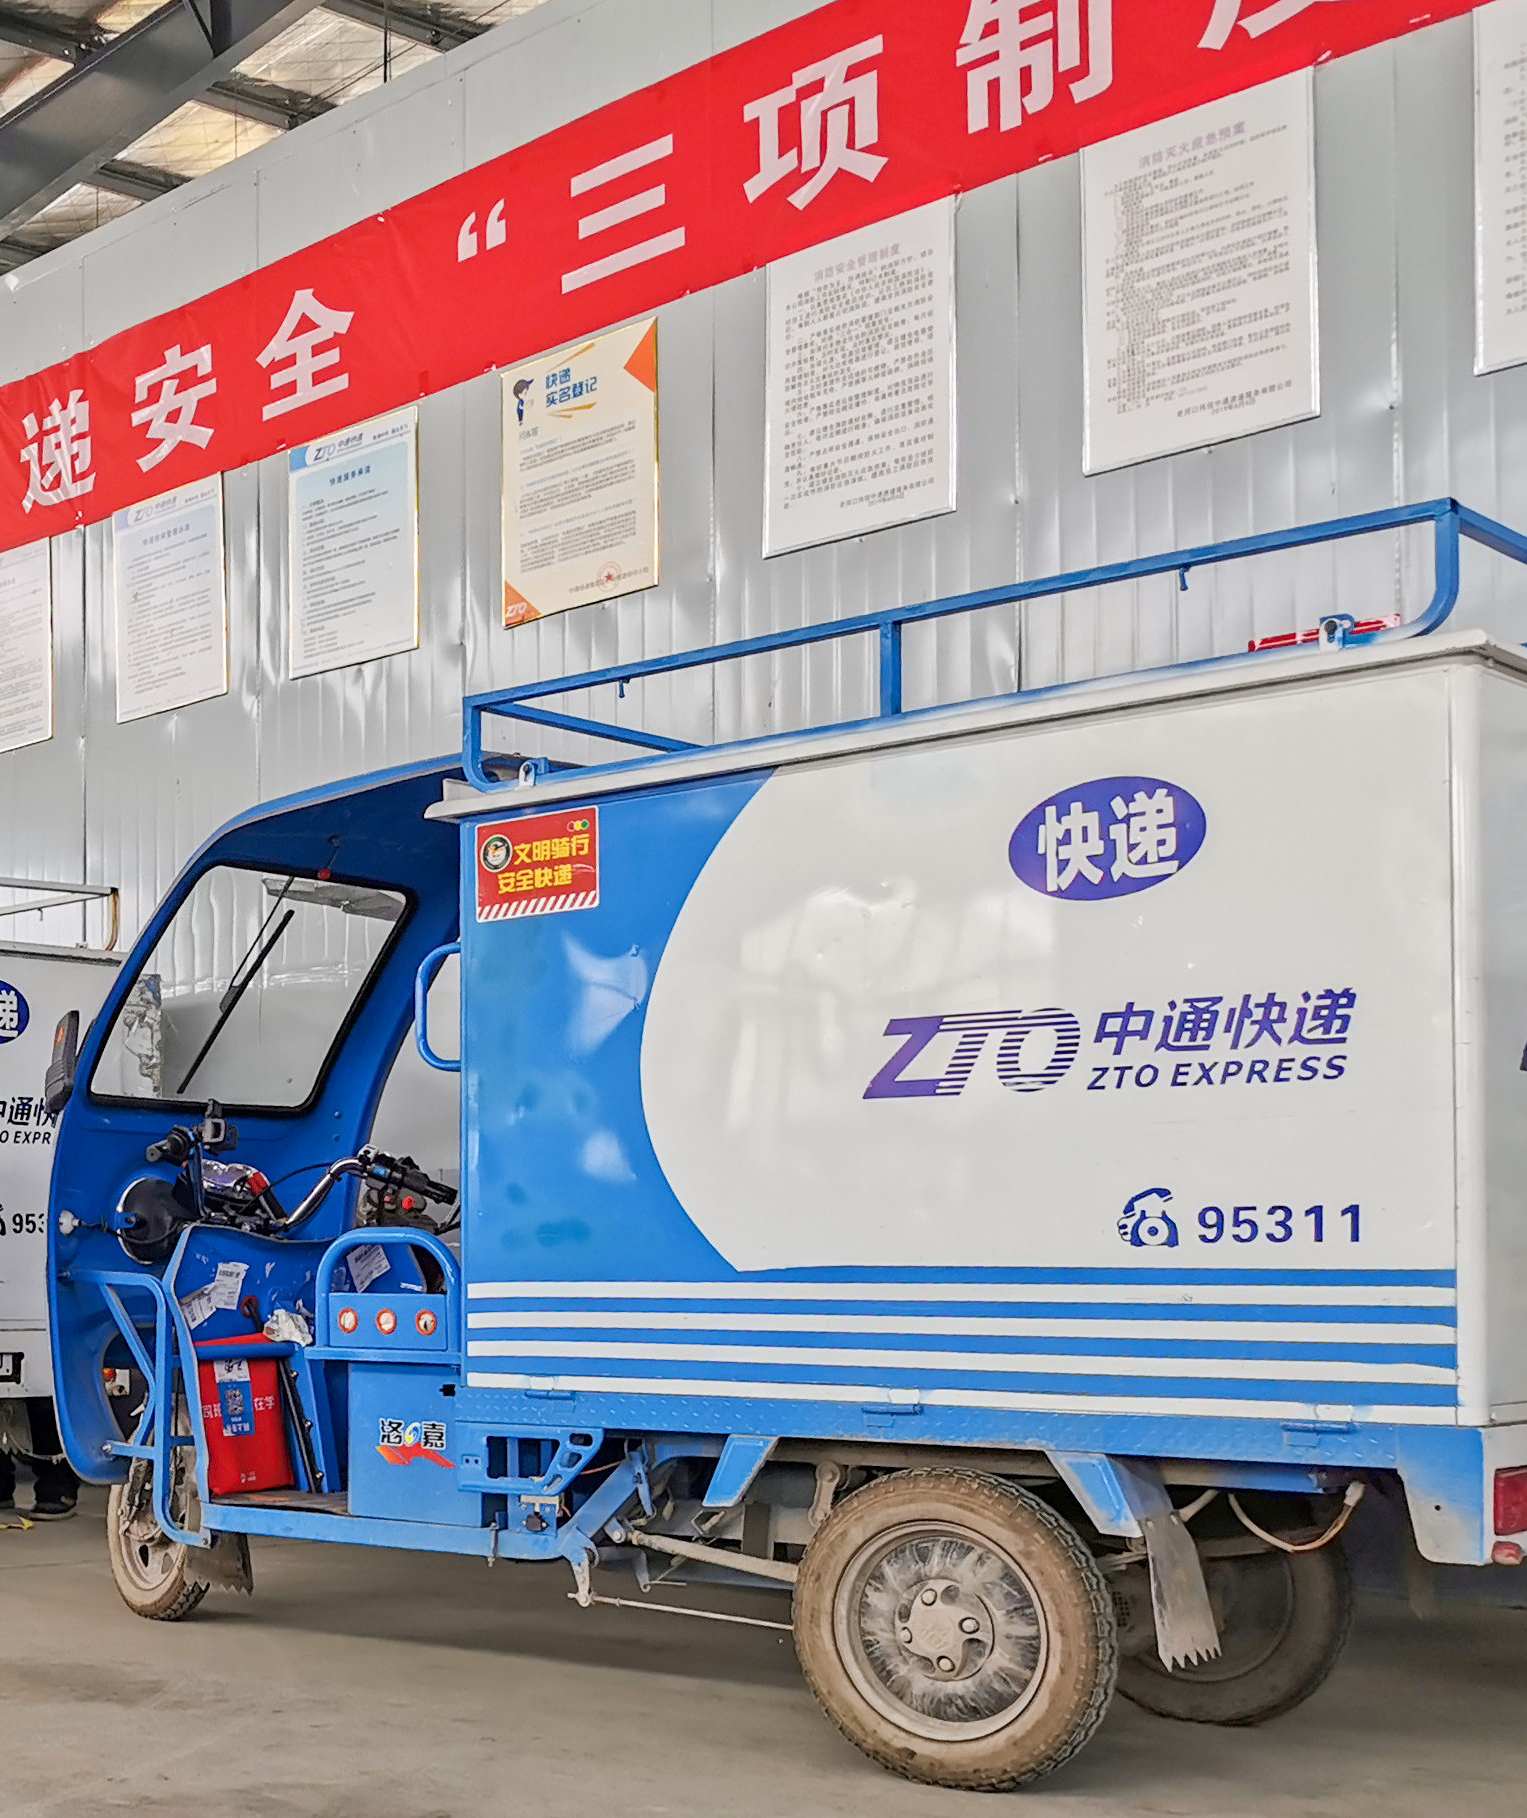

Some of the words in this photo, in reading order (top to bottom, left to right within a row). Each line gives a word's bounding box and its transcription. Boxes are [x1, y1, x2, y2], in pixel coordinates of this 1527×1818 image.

[813, 242, 900, 284] 消防安全管理制度
[545, 367, 571, 390] 快递
[545, 376, 597, 408] 实名登记
[313, 442, 336, 463] ZTO
[505, 602, 527, 619] ZTO
[514, 834, 590, 865] 文明骑行
[1036, 788, 1180, 892] 快递
[498, 864, 572, 894] 安全快递
[861, 1007, 1081, 1099] ZTO
[1092, 987, 1357, 1056] 中通快递
[1087, 1063, 1159, 1090] ZTO
[1170, 1054, 1347, 1087] EXPRESS
[13, 1130, 51, 1144] EXPR
[1196, 1204, 1362, 1243] 95311
